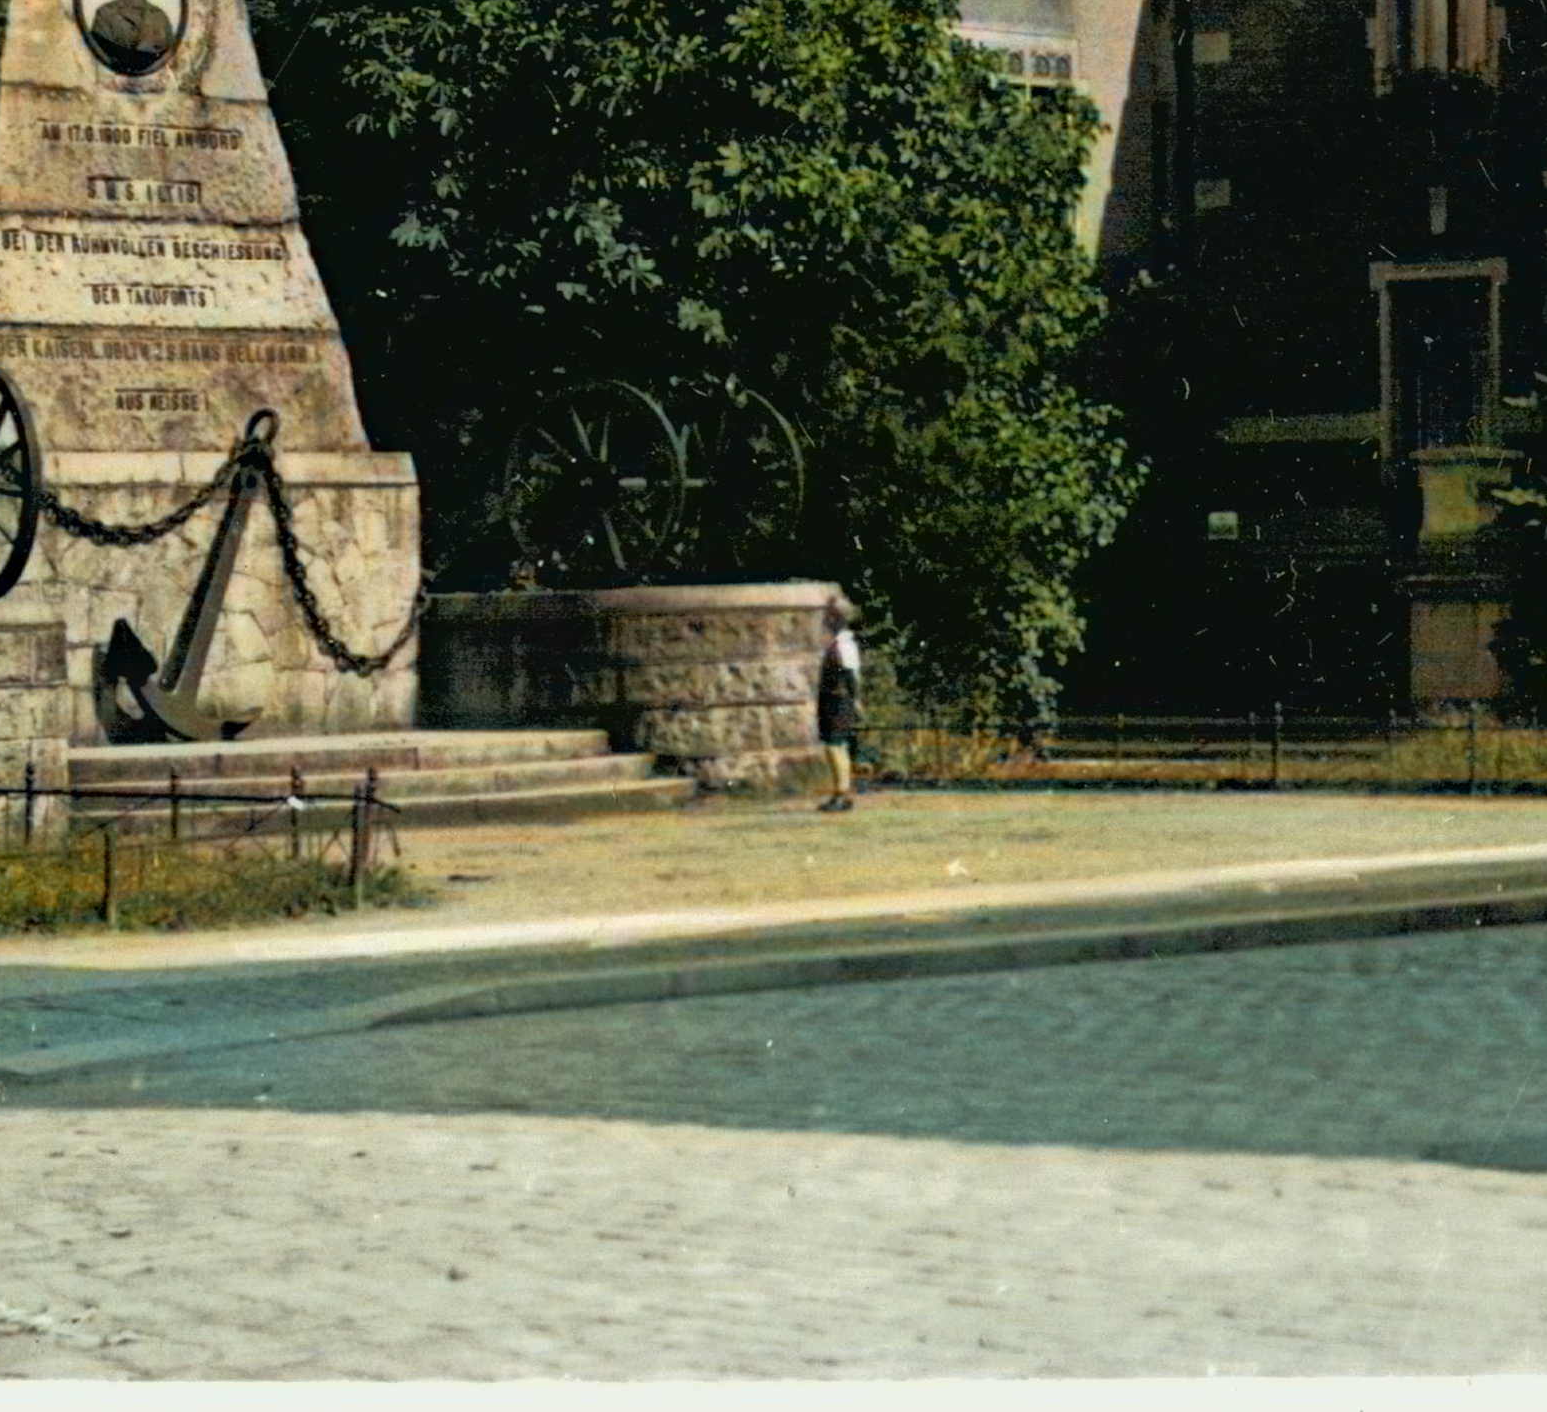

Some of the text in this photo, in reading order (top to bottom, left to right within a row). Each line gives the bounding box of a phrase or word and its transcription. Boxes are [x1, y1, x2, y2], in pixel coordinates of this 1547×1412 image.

[138, 128, 170, 148] FIEL
[146, 183, 196, 204] ILTIS
[1, 233, 27, 252] BEI
[34, 233, 65, 253] DER
[172, 240, 283, 262] BESCHIESSUNG
[91, 287, 121, 305] DER
[116, 392, 144, 411] AUS
